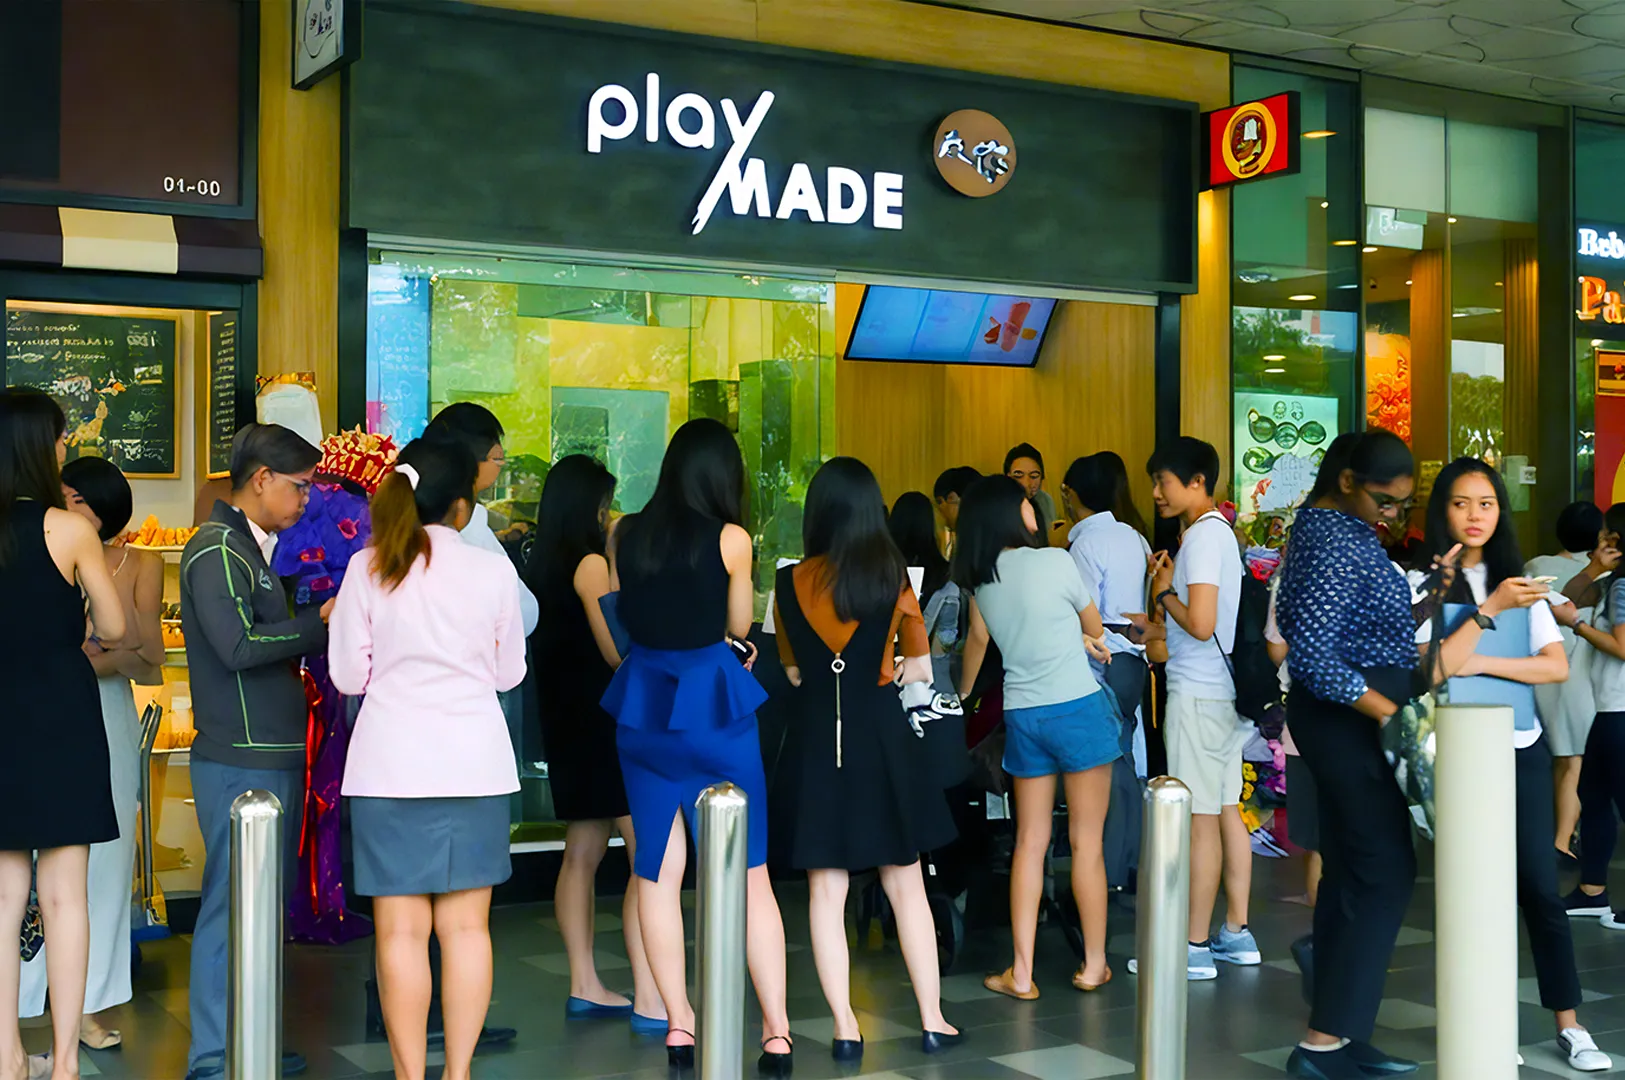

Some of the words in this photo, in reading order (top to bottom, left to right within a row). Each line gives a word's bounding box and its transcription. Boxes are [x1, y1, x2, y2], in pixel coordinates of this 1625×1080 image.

[587, 72, 775, 170] play
[691, 157, 904, 235] MADE
[1578, 228, 1625, 259] Beb
[1576, 276, 1625, 324] Pa
